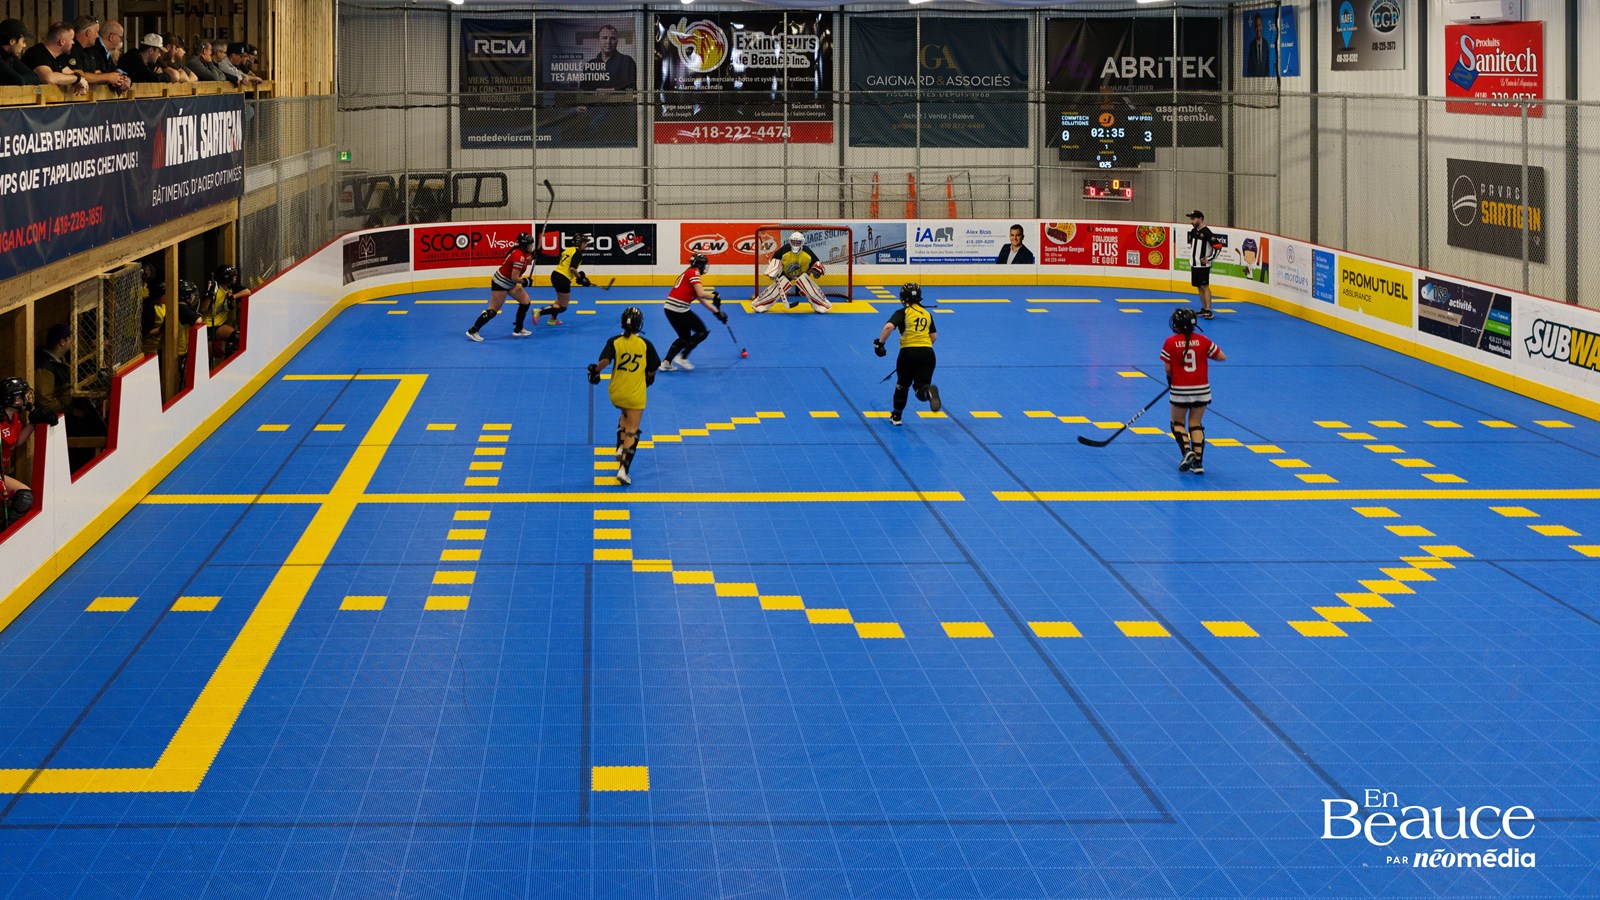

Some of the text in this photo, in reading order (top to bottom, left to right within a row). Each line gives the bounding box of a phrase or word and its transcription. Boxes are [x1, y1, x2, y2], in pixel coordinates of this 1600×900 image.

[174, 3, 243, 17] SALLE
[1373, 12, 1398, 28] EGB
[204, 28, 228, 39] DE
[474, 39, 526, 54] RCM
[1475, 38, 1500, 47] Produits
[792, 55, 808, 65] Inc.
[1460, 34, 1538, 73] Sanitech
[551, 62, 606, 71] MODULE POUR
[468, 76, 532, 85] VIENS TRAVAILLER
[550, 72, 610, 82] TES AMBITIONS
[867, 75, 935, 87] GAIGNARD
[946, 74, 1011, 87] ASSOCIÉS
[1155, 105, 1206, 113] assmble.
[903, 112, 922, 120] Acht
[1163, 113, 1217, 122] rasemble.
[13, 132, 53, 156] GOALER
[55, 129, 66, 150] EN
[67, 125, 104, 148] PENSANT
[105, 120, 111, 142] À
[112, 123, 127, 142] TON
[127, 121, 146, 140] BOSS,
[165, 108, 242, 167] MÉTAL SARTIGAN
[1062, 130, 1070, 141] 0
[1091, 128, 1125, 138] 02:35
[1144, 131, 1152, 142] 3
[19, 168, 40, 192] QUE
[42, 159, 95, 187] T'APPLIQUES
[97, 155, 114, 176] CHEZ
[152, 164, 242, 207] BÂTIMENTS D'ACIER OPTIMISÉS
[1481, 183, 1520, 200] PAVAG
[53, 205, 103, 236] 418-228-1851
[915, 227, 934, 243] iA
[1092, 235, 1118, 243] TOUJOURS
[421, 232, 482, 252] SCOOP
[691, 242, 725, 251] A&W
[1092, 243, 1118, 257] PLUS
[1102, 256, 1118, 265] GOÛT
[1343, 269, 1409, 301] PROMUTUEL
[1343, 288, 1372, 302] ASSURANCE
[1449, 299, 1472, 312] activité
[914, 317, 927, 332] 19
[1175, 340, 1200, 348] LESARD
[617, 353, 643, 373] 25
[1183, 349, 1197, 373] 9
